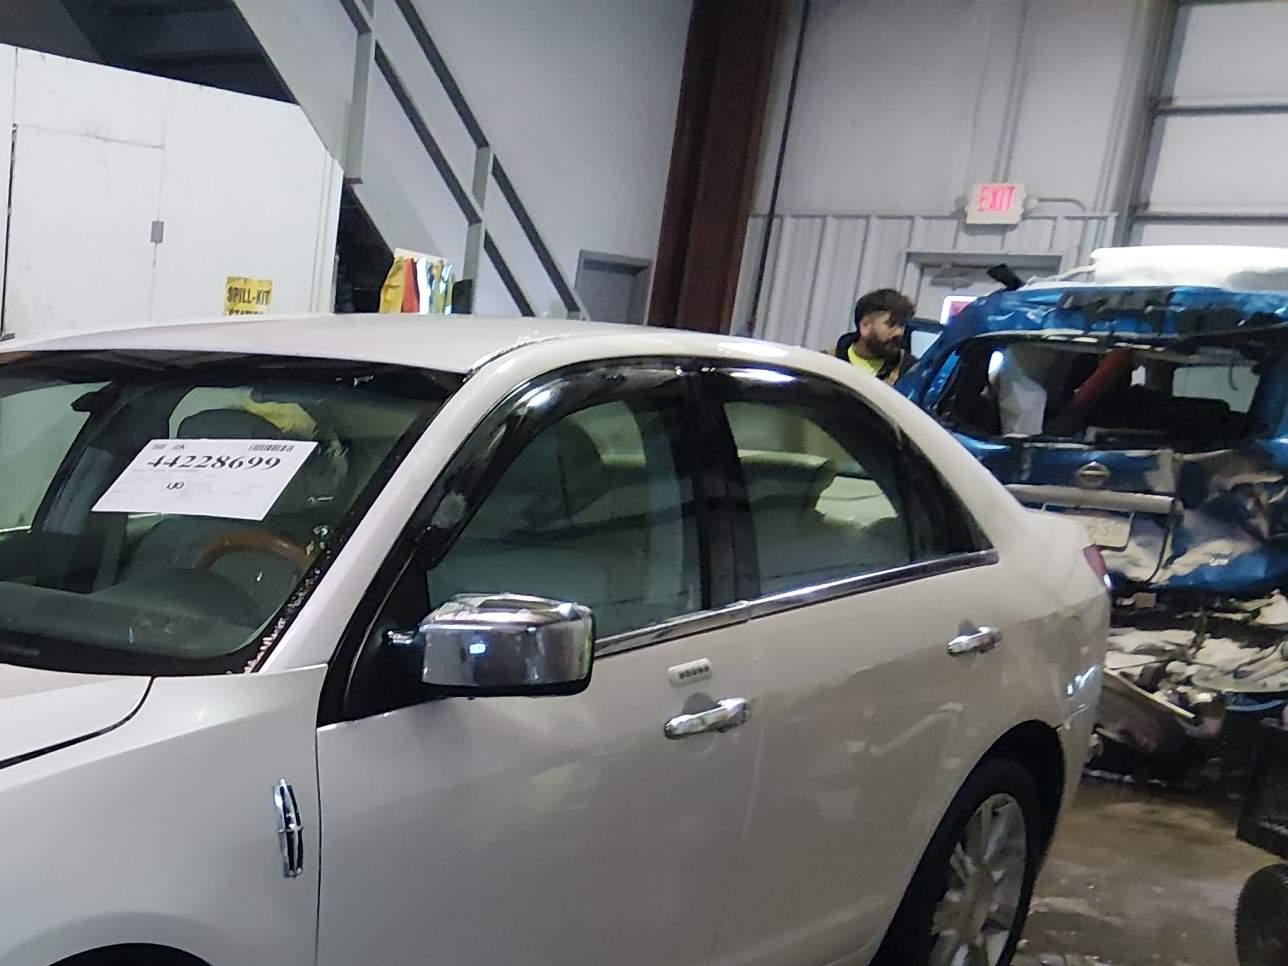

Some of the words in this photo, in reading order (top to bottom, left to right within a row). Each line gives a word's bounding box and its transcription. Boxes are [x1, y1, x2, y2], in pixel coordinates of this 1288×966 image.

[977, 185, 1016, 212] EXIT
[227, 286, 272, 306] SPILL-KIT
[147, 455, 281, 470] 44228699
